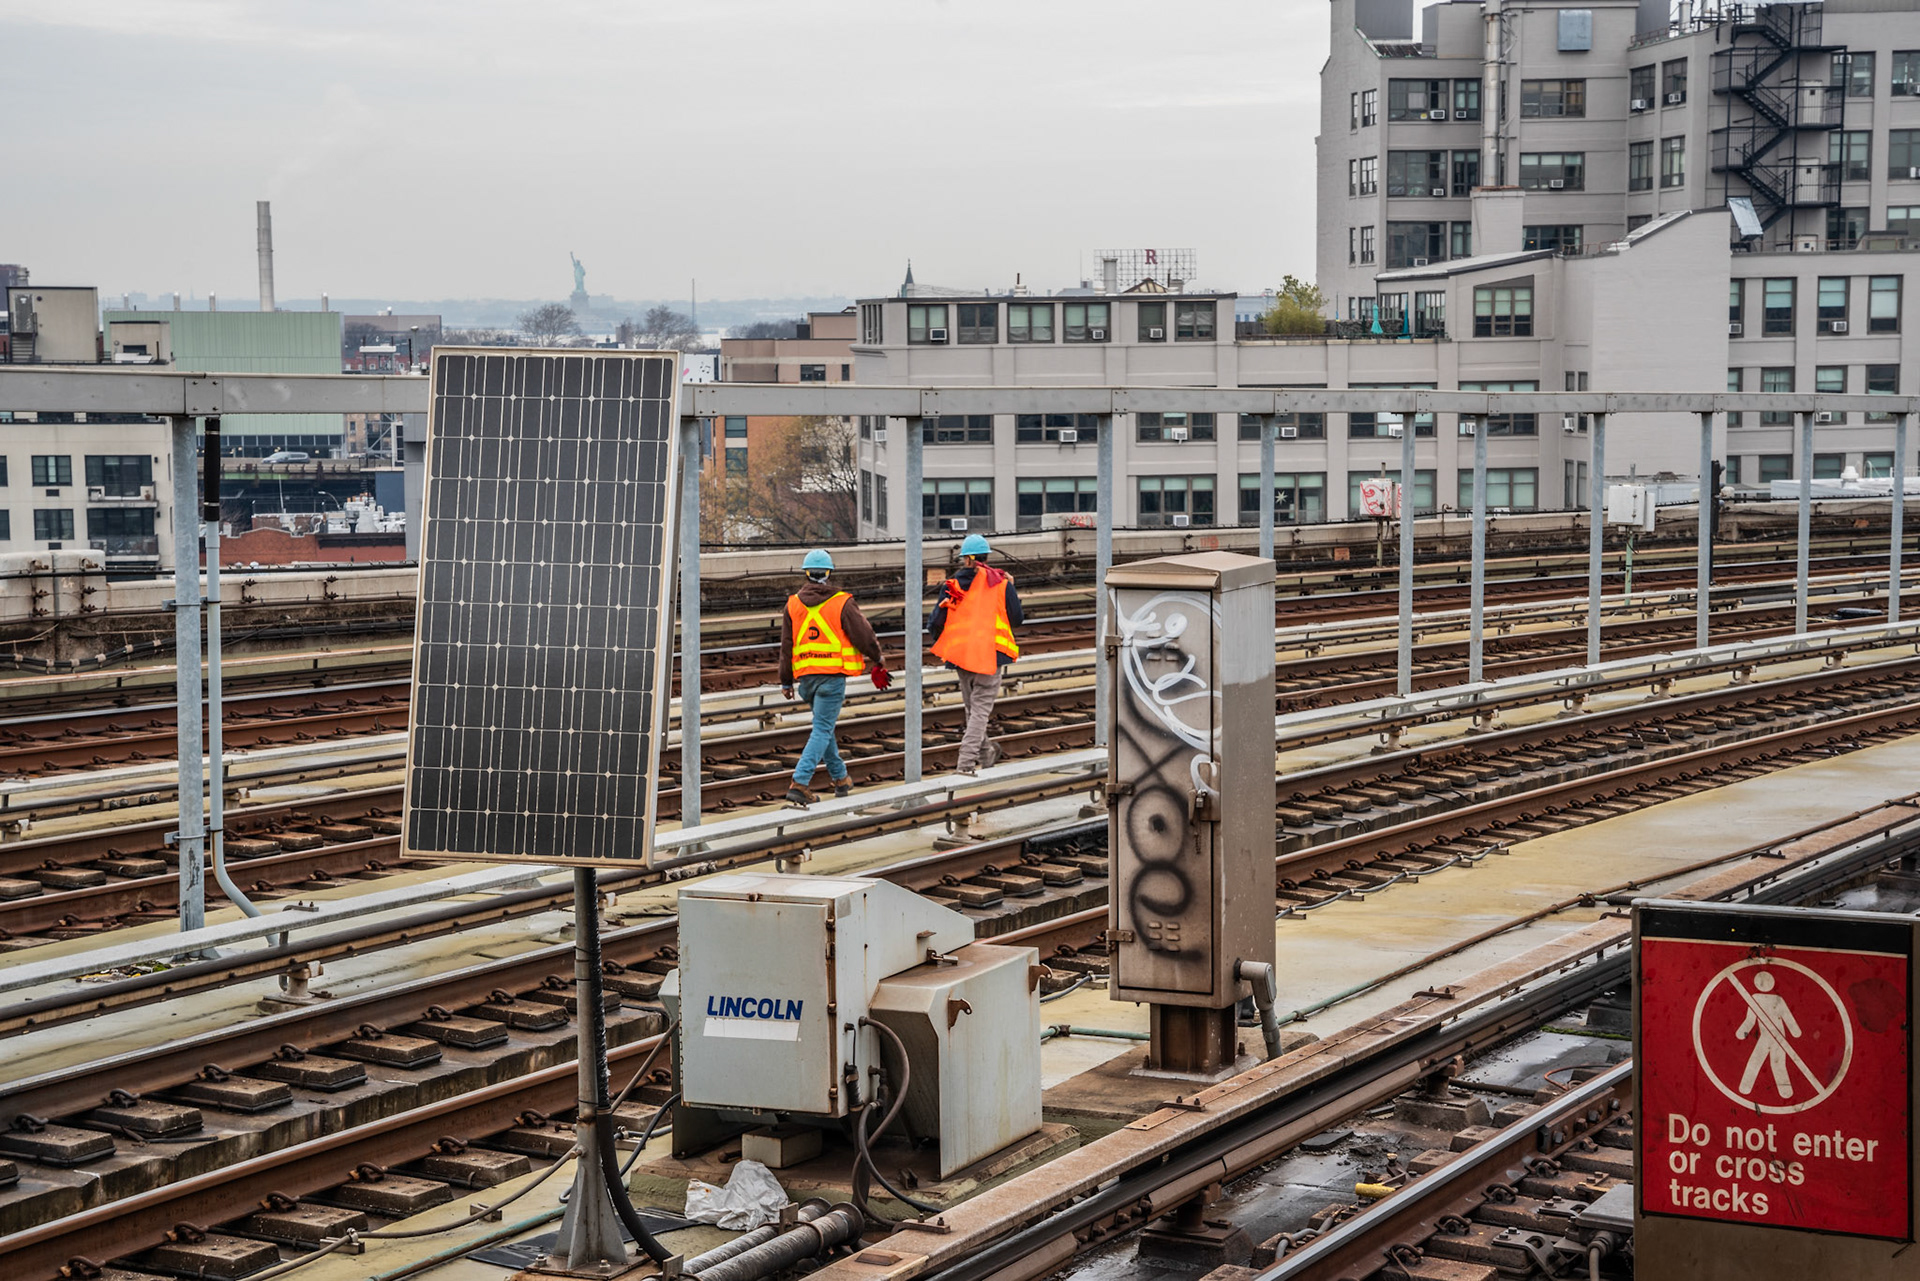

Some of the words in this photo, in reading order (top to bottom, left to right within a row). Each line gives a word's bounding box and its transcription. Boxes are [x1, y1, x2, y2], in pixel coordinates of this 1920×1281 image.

[1145, 249, 1158, 264] R
[707, 995, 803, 1020] LINCOLN
[1668, 1113, 1711, 1147] Do
[1726, 1124, 1777, 1153] not
[1793, 1130, 1879, 1162] enter
[1669, 1150, 1701, 1175] or
[1715, 1154, 1805, 1186] cross
[1669, 1178, 1769, 1215] tracks
